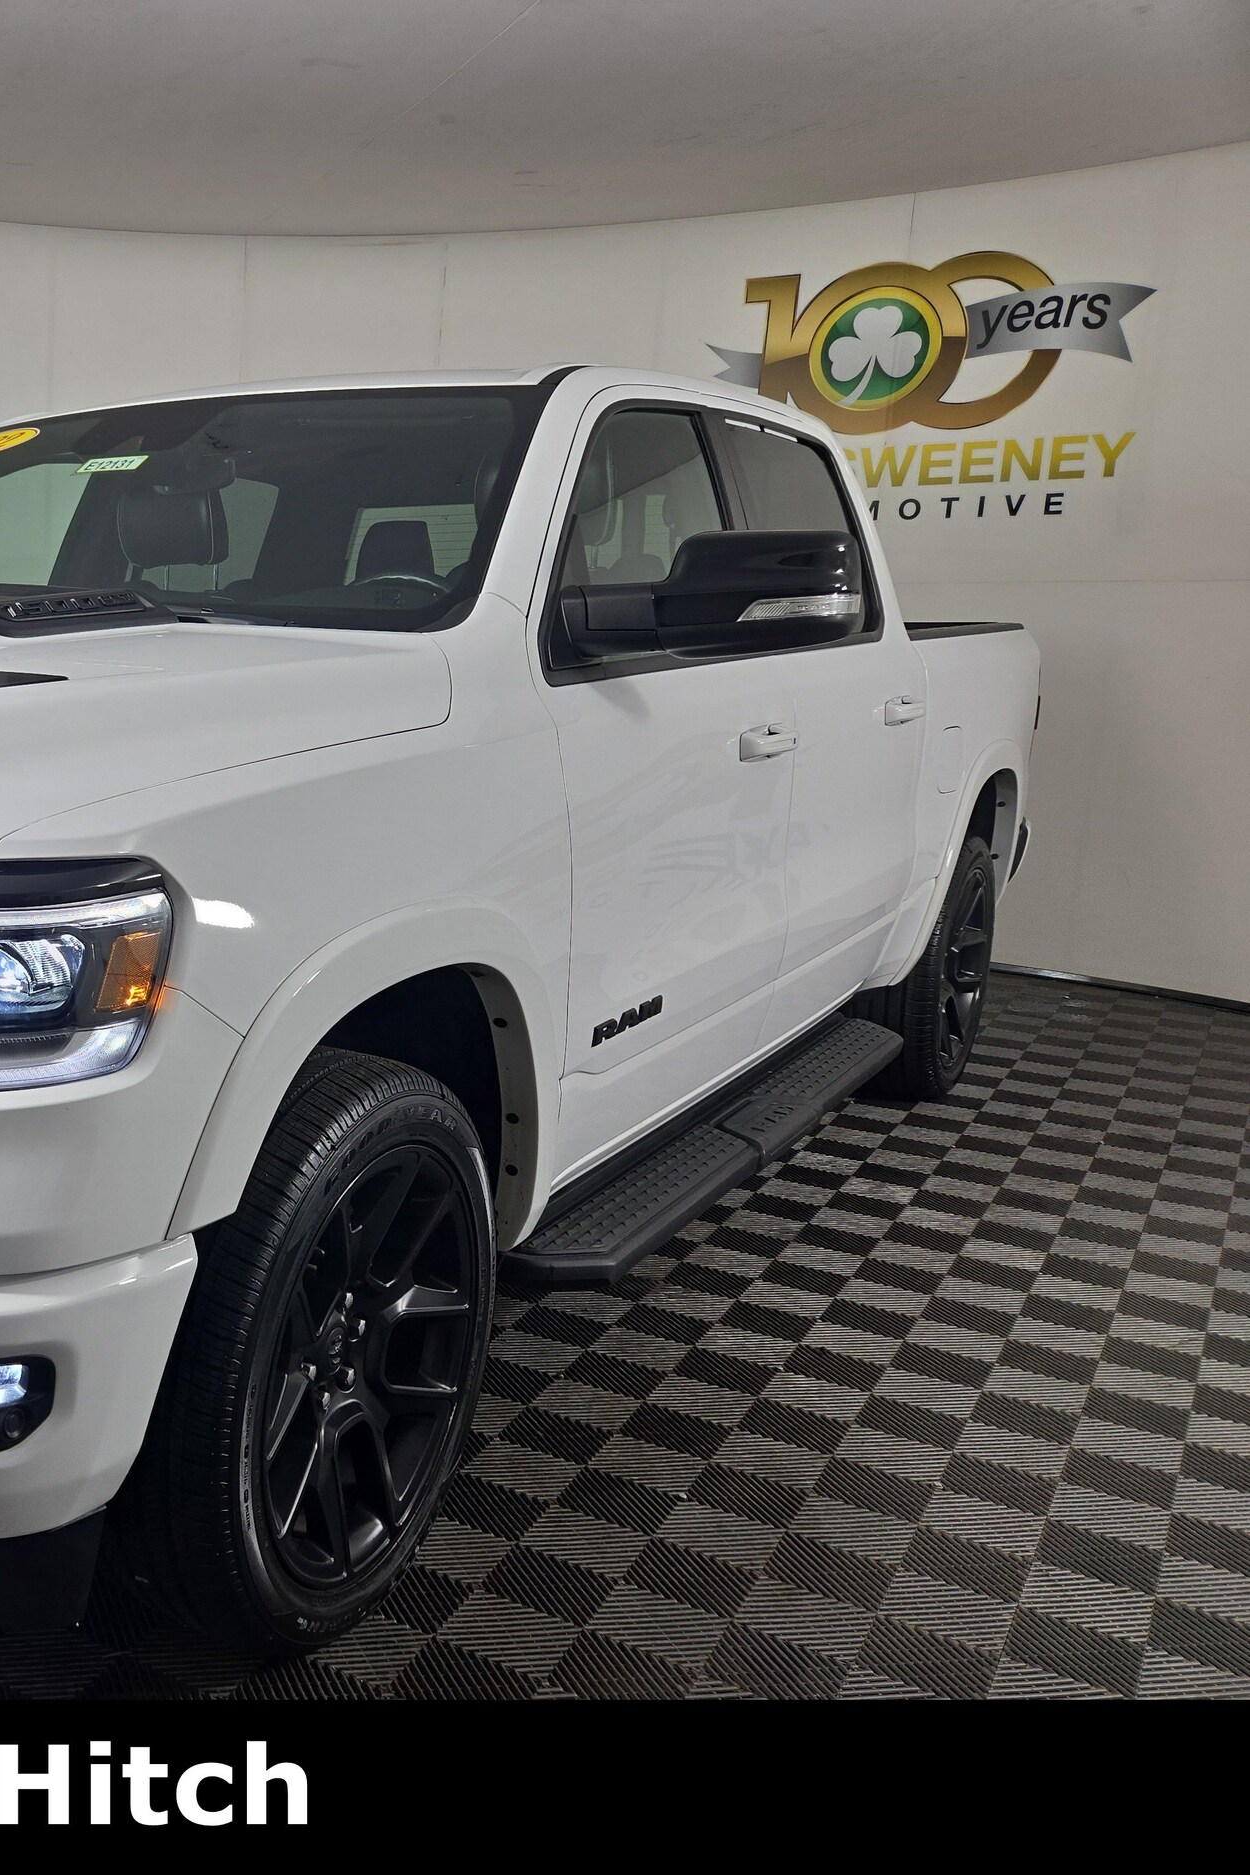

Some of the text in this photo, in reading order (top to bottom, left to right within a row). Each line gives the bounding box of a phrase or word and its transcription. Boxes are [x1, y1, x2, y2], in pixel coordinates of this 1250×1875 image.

[976, 292, 1111, 350] years
[84, 458, 136, 471] E12131
[1, 596, 97, 618] 1500
[591, 994, 663, 1048] RAM
